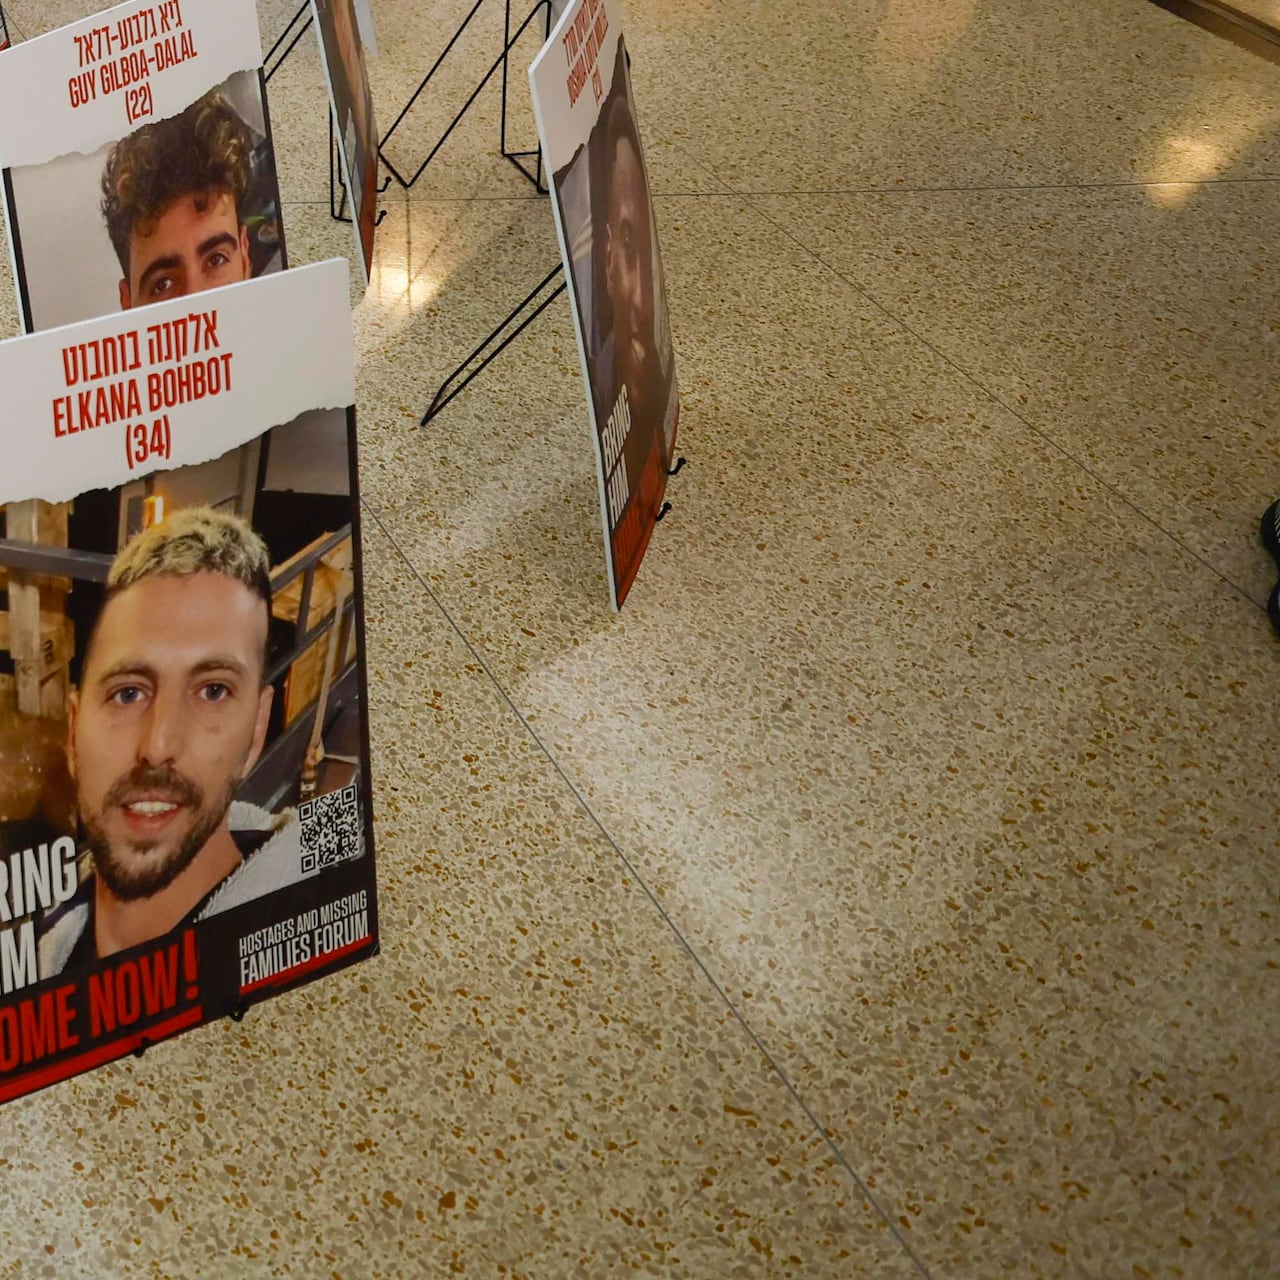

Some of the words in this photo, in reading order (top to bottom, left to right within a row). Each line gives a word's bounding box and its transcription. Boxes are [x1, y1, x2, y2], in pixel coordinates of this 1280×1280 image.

[68, 69, 97, 109] GUY
[100, 29, 198, 95] GILBOA-DALAL
[73, 8, 158, 68] גלבוע-דלאל
[125, 81, 154, 126] (22)
[62, 330, 142, 388] בוחבוט
[147, 309, 221, 365] אלקנה
[52, 378, 143, 439] ELKANA
[147, 352, 234, 413] BOHBOT
[602, 384, 631, 479] BRING
[125, 414, 172, 471] (34)
[608, 451, 630, 529] HIM
[239, 918, 295, 958] HOSTAGES
[296, 909, 319, 936] AND
[320, 889, 368, 927] MISSING
[240, 933, 311, 988] FAMILIES
[314, 910, 369, 958] FORUM
[88, 928, 200, 1039] NOW!
